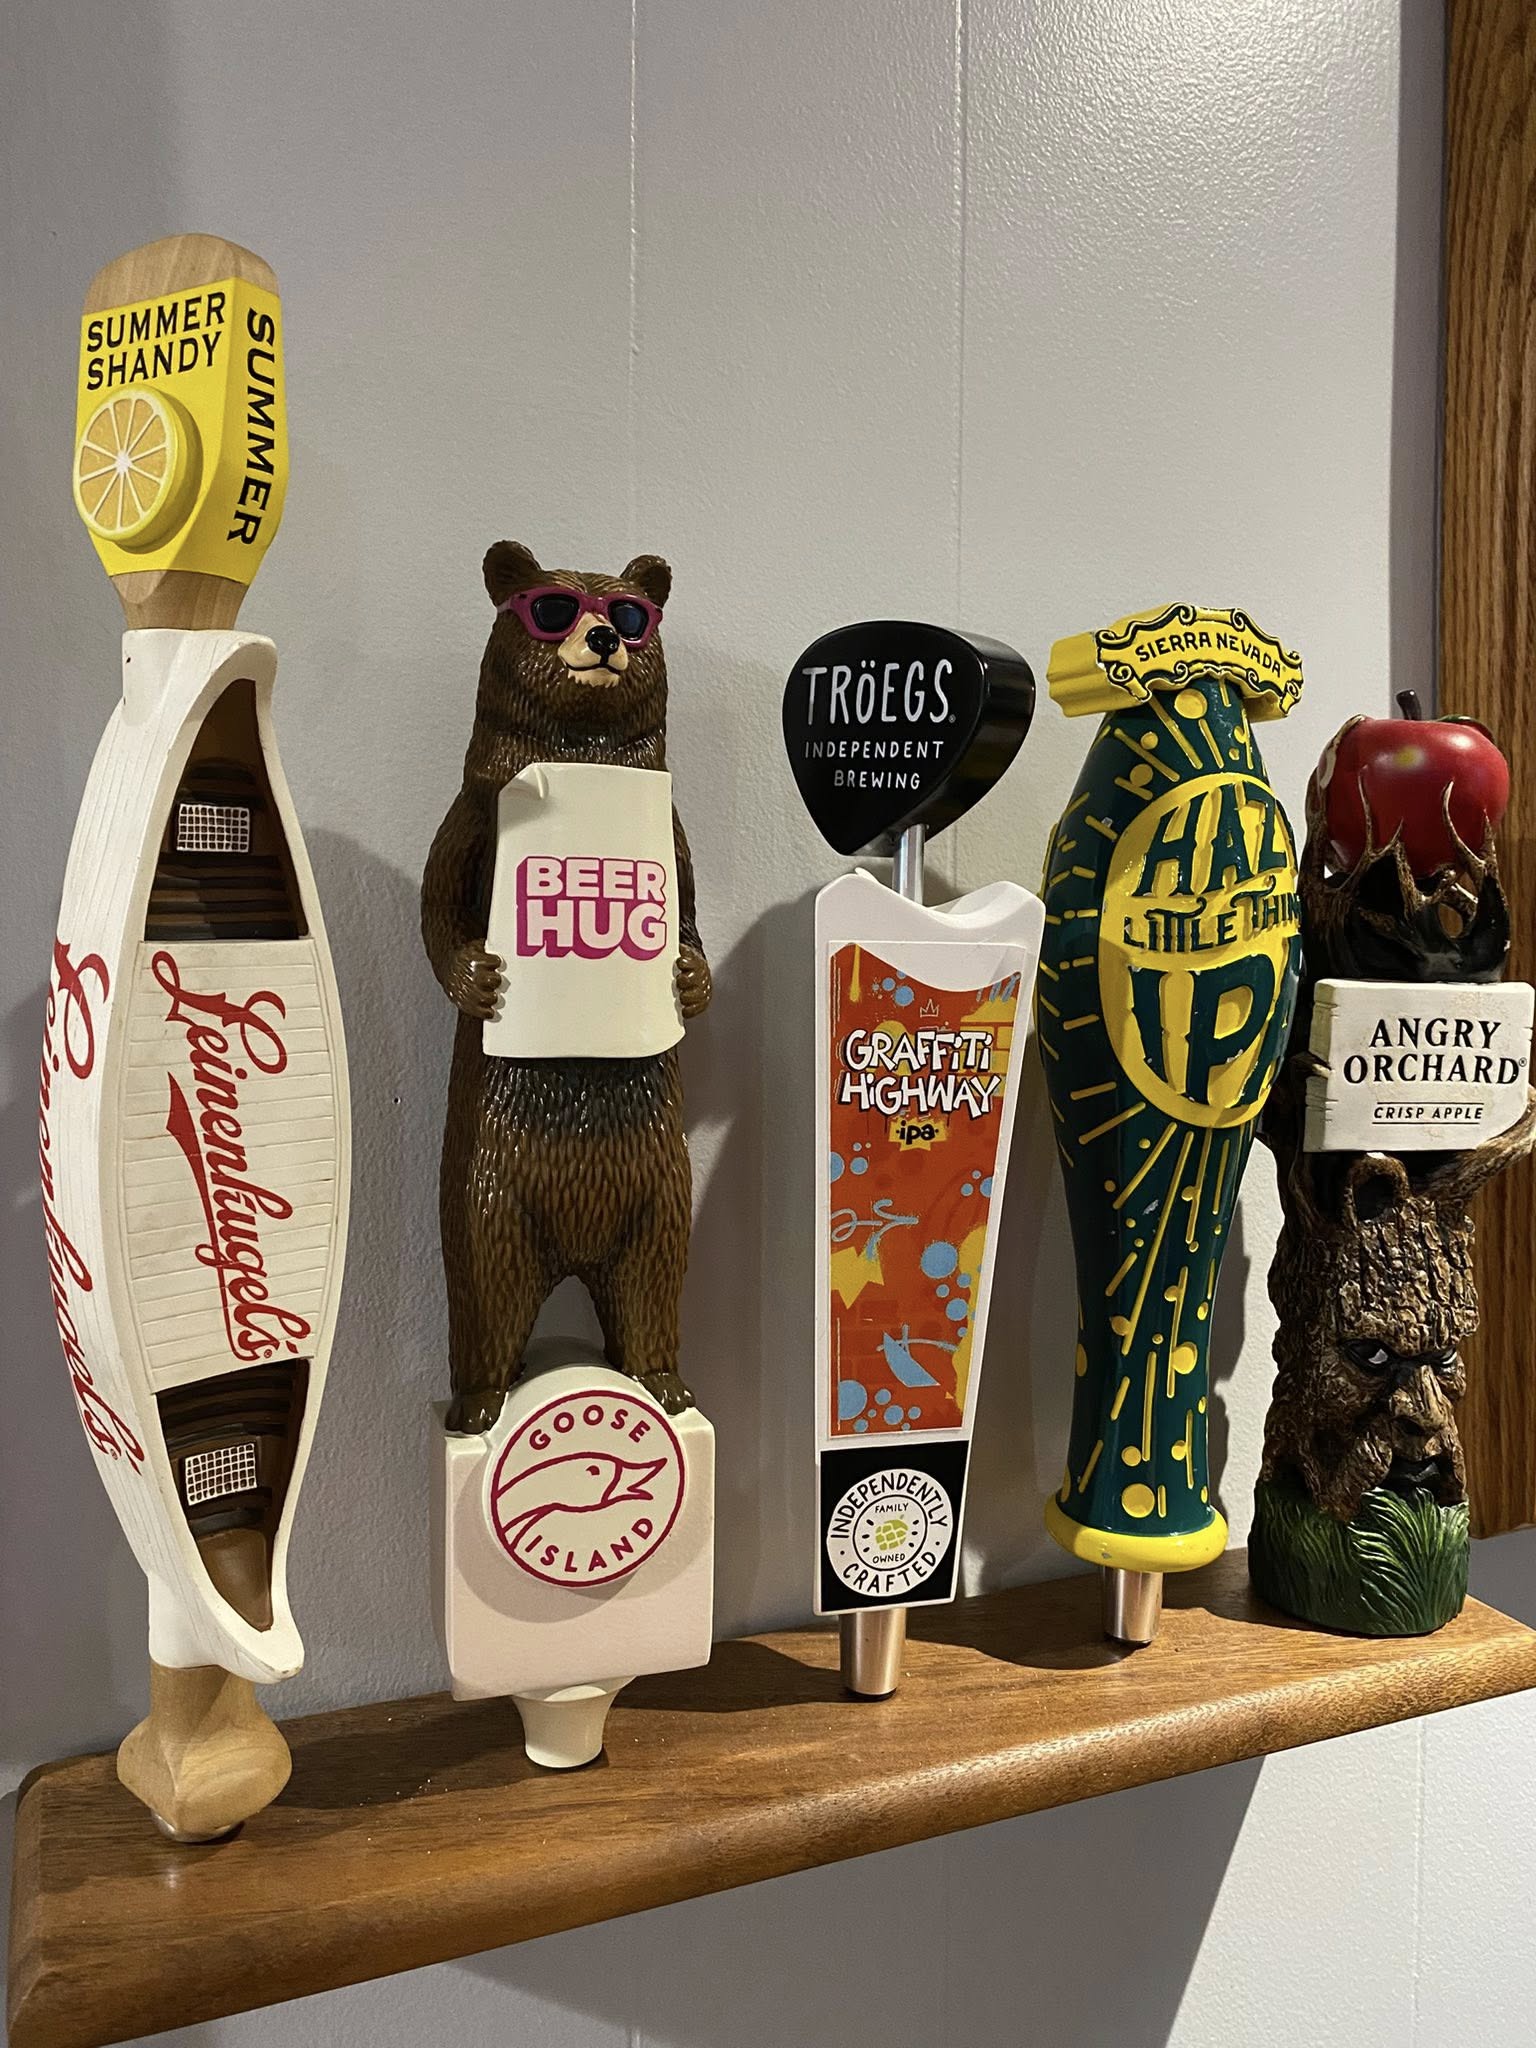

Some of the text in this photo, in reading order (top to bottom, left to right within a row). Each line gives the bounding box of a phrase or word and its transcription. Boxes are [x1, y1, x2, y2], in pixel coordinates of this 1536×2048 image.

[86, 291, 227, 353] SUMMER
[86, 331, 222, 391] SHANDY
[226, 307, 276, 546] SUMMER
[1134, 632, 1283, 679] SIERRA NEVADA
[802, 658, 953, 726] TRÖEGS
[804, 740, 944, 759] INDEPENDENT
[833, 769, 921, 790] BREWING
[1135, 780, 1298, 897] HAZ
[516, 856, 667, 903] BEER
[1231, 874, 1302, 930] THIN
[516, 898, 667, 961] HUG
[1369, 1018, 1501, 1049] ANGRY
[1343, 1053, 1520, 1085] ORCHARD
[1373, 1107, 1484, 1120] CRISP APPLE
[151, 949, 313, 1363] Leinenkugel's
[529, 1404, 651, 1451] GOOSE
[830, 1472, 949, 1539] INDEPENDENTLY
[874, 1502, 910, 1514] FAMILY
[524, 1518, 653, 1573] ISLAND
[872, 1553, 906, 1565] OWNED
[842, 1551, 937, 1594] CRAFTED
